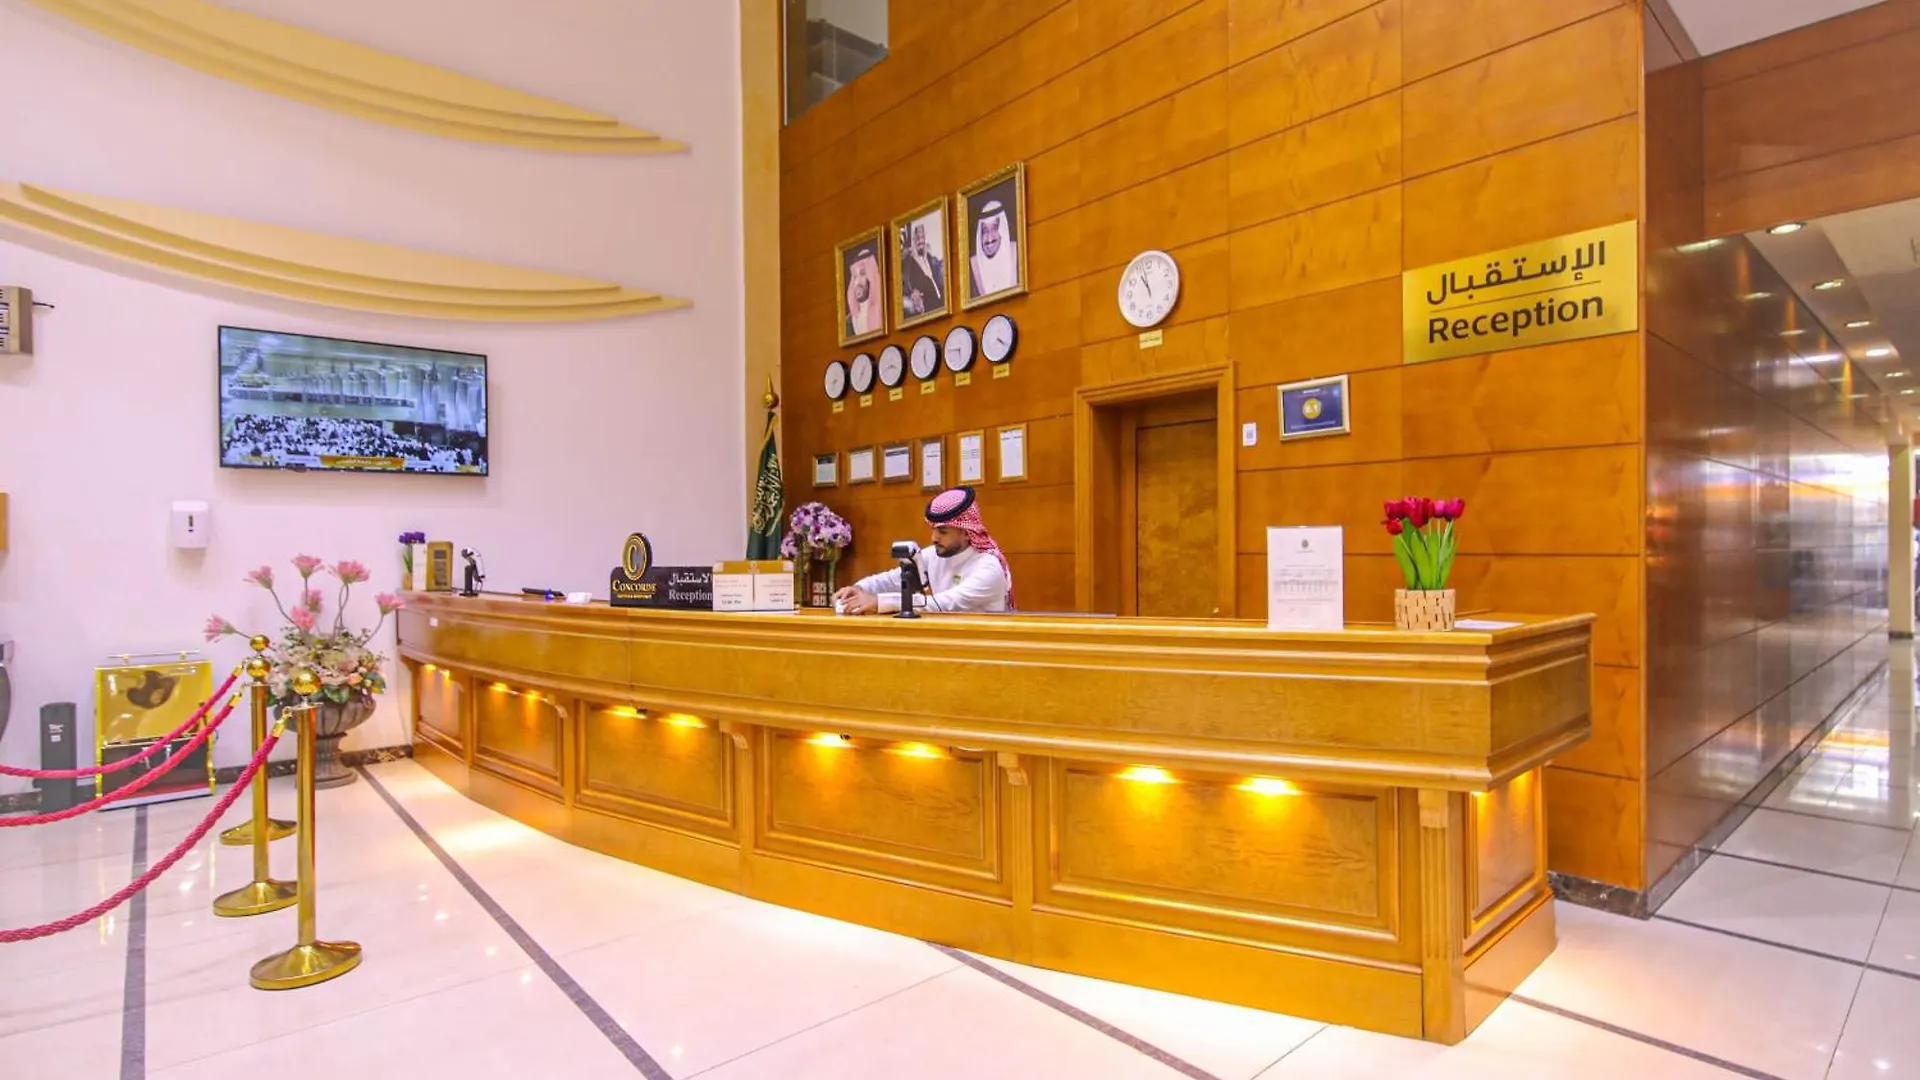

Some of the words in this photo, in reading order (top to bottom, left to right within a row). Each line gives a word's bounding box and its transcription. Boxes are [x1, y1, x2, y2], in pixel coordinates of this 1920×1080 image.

[1426, 240, 1606, 306] الإستقبال
[1428, 296, 1604, 344] Reception
[668, 588, 713, 604] Reception
